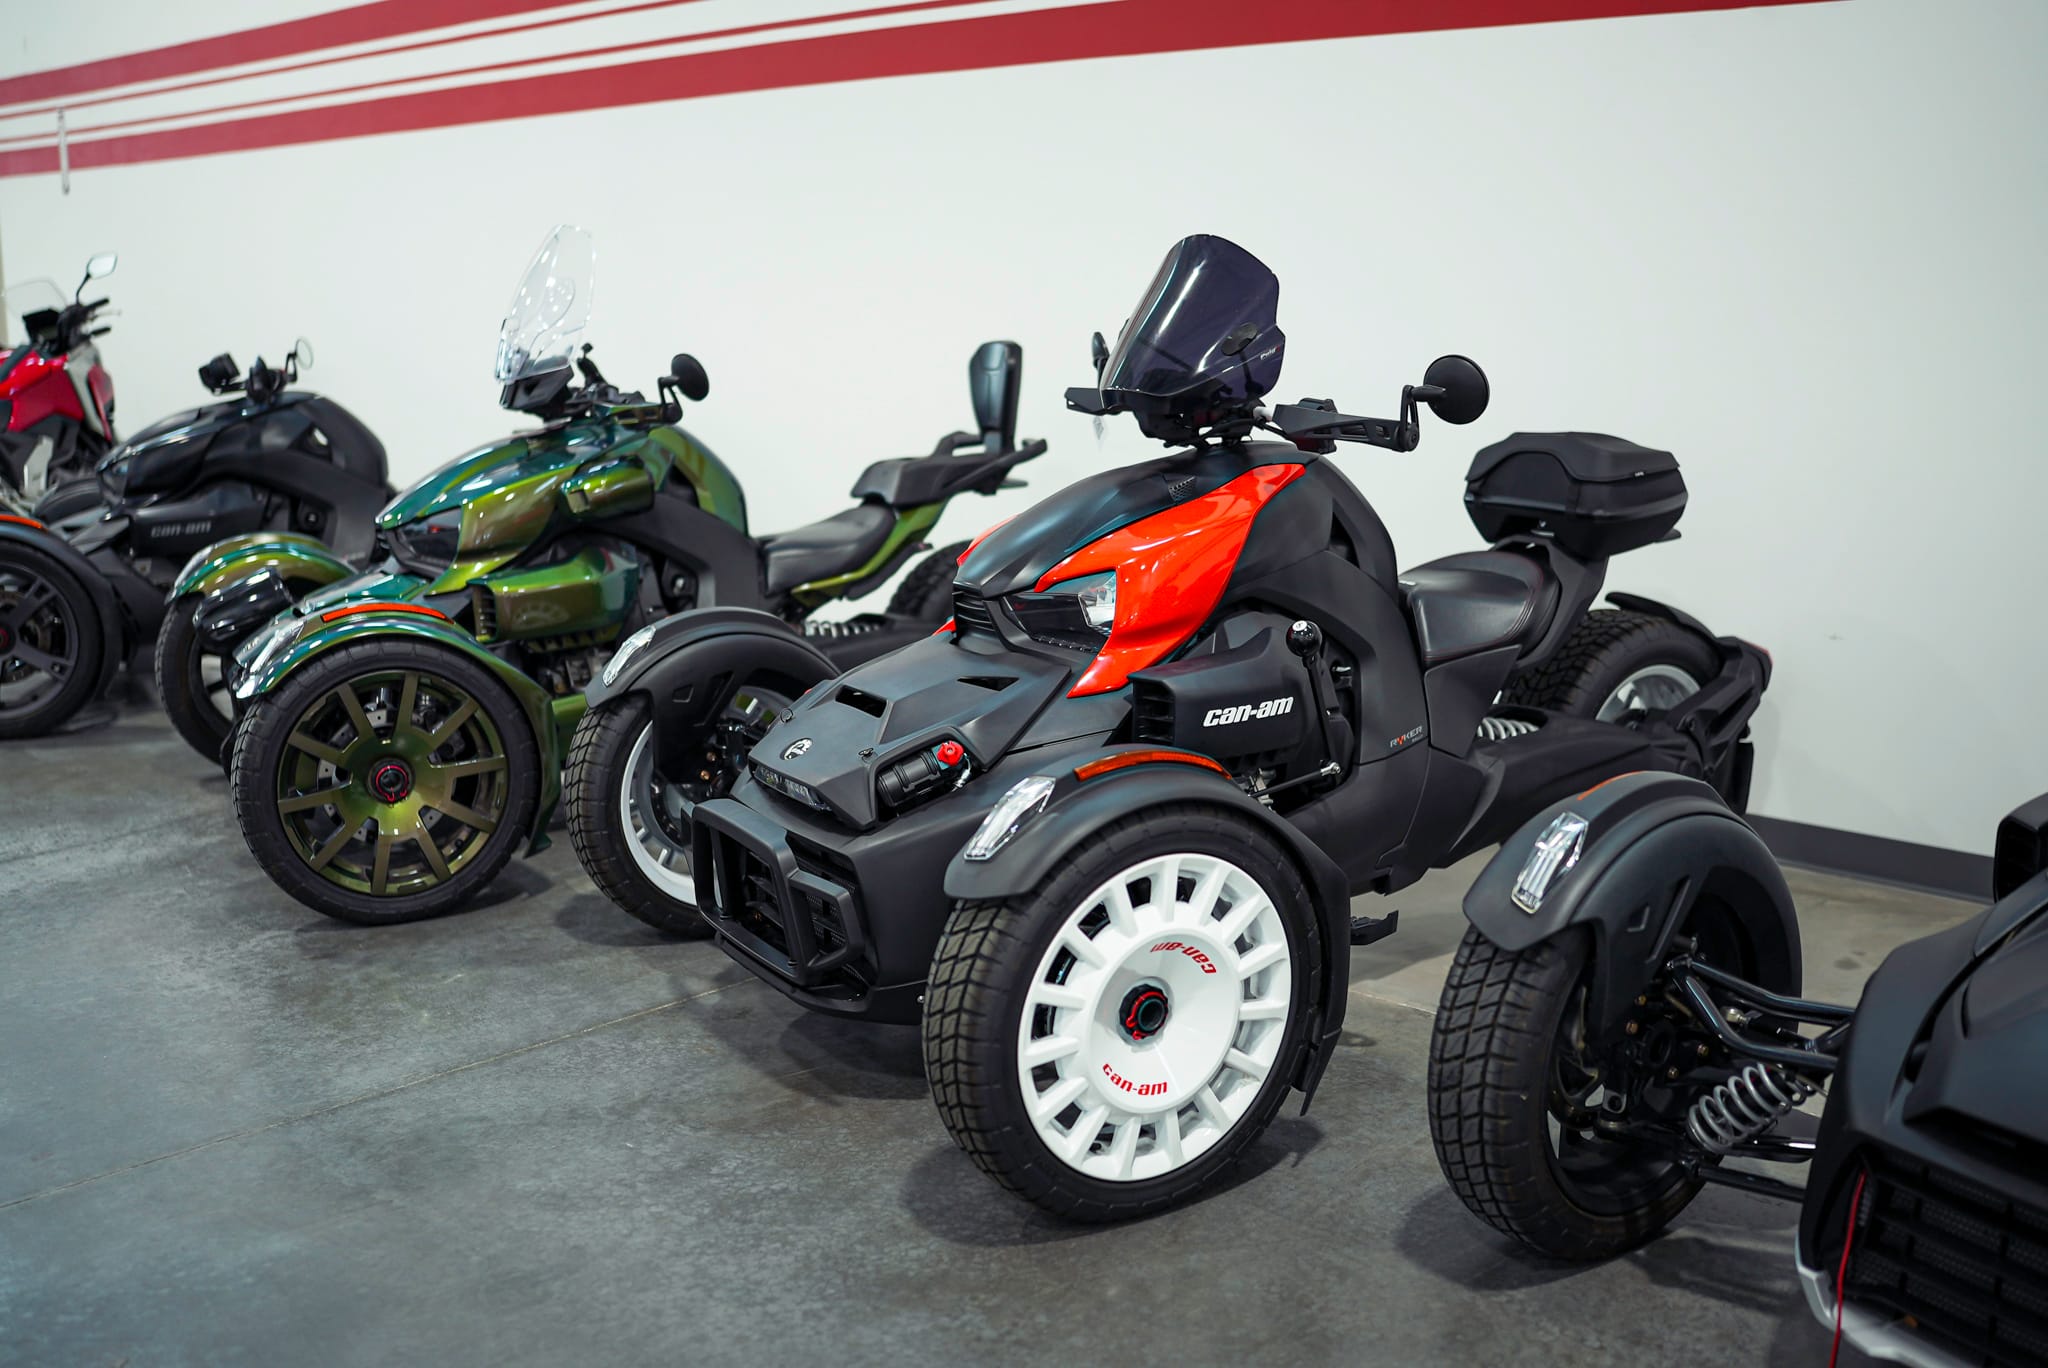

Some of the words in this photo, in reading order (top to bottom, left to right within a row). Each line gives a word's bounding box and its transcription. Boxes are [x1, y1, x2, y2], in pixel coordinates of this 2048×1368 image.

[1203, 696, 1294, 727] can-am
[1390, 725, 1422, 748] RYKER
[1150, 942, 1217, 973] can-am
[1103, 1064, 1167, 1095] can-am
